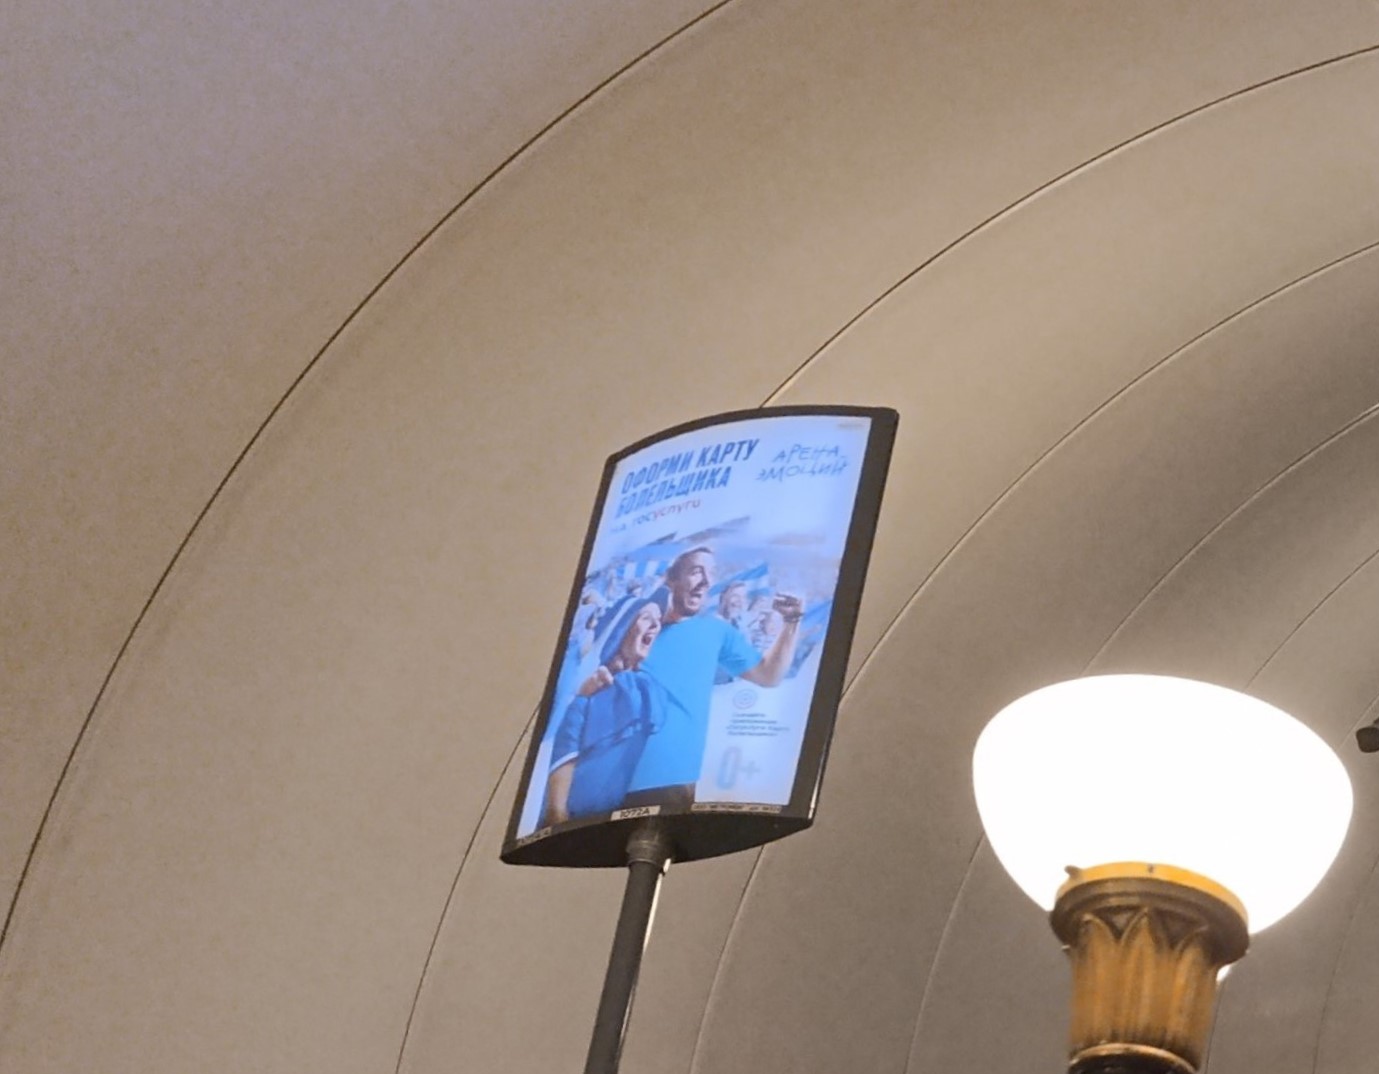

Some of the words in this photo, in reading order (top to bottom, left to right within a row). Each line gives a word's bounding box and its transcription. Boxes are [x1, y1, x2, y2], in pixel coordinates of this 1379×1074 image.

[615, 466, 732, 519] БОЛЕЛЬЩИКА
[621, 450, 694, 495] ОФОРМИ
[696, 438, 760, 468] КАРТУ
[716, 746, 761, 790] 0+
